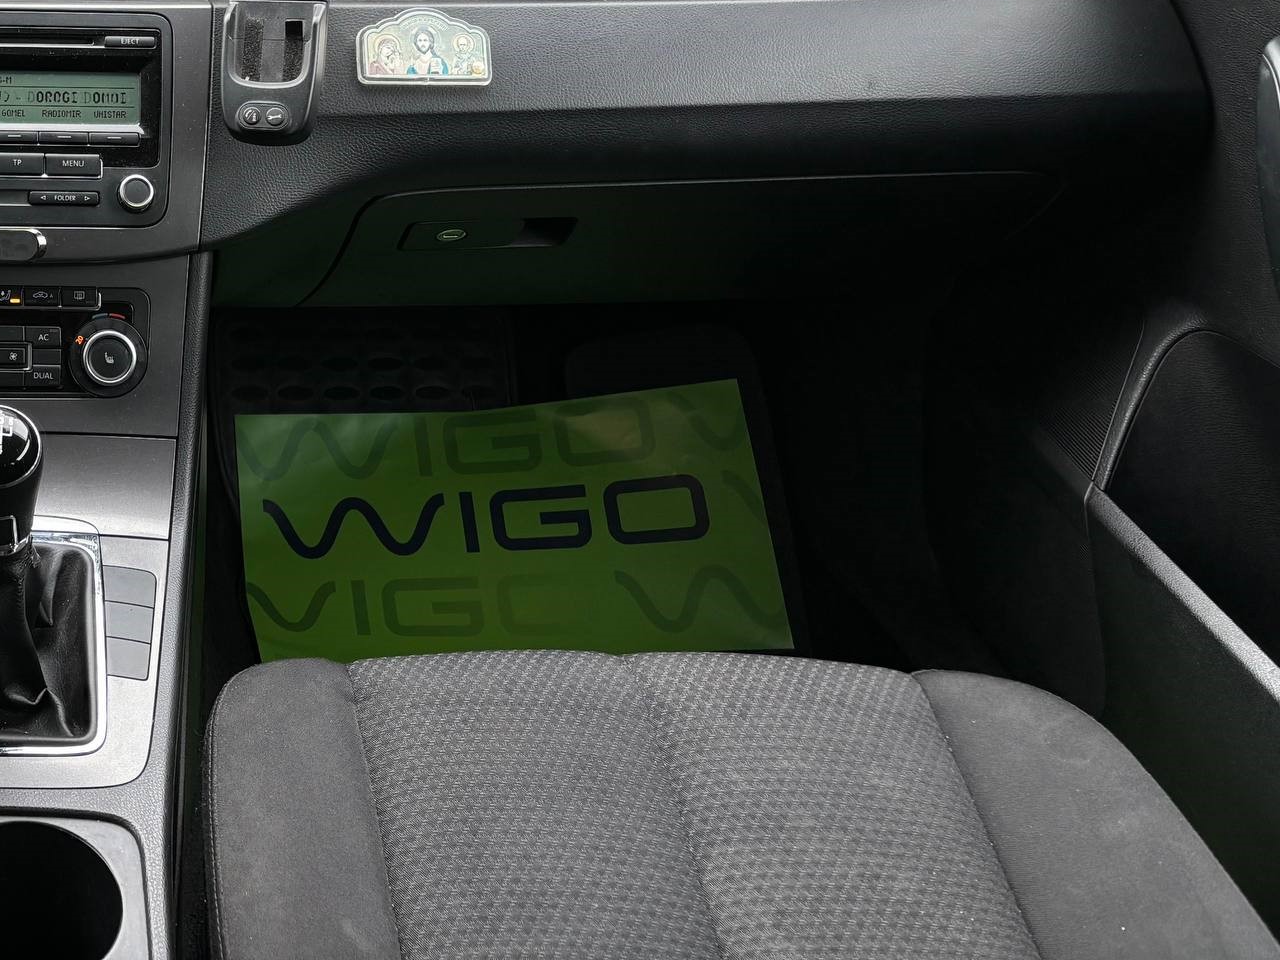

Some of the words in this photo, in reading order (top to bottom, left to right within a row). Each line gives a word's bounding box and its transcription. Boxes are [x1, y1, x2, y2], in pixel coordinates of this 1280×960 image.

[1, 110, 26, 118] GOMEL
[42, 110, 82, 119] RADIOMIR
[62, 160, 85, 168] MENU
[38, 333, 49, 341] AC
[75, 335, 84, 345] 20
[262, 473, 711, 560] WIGO
